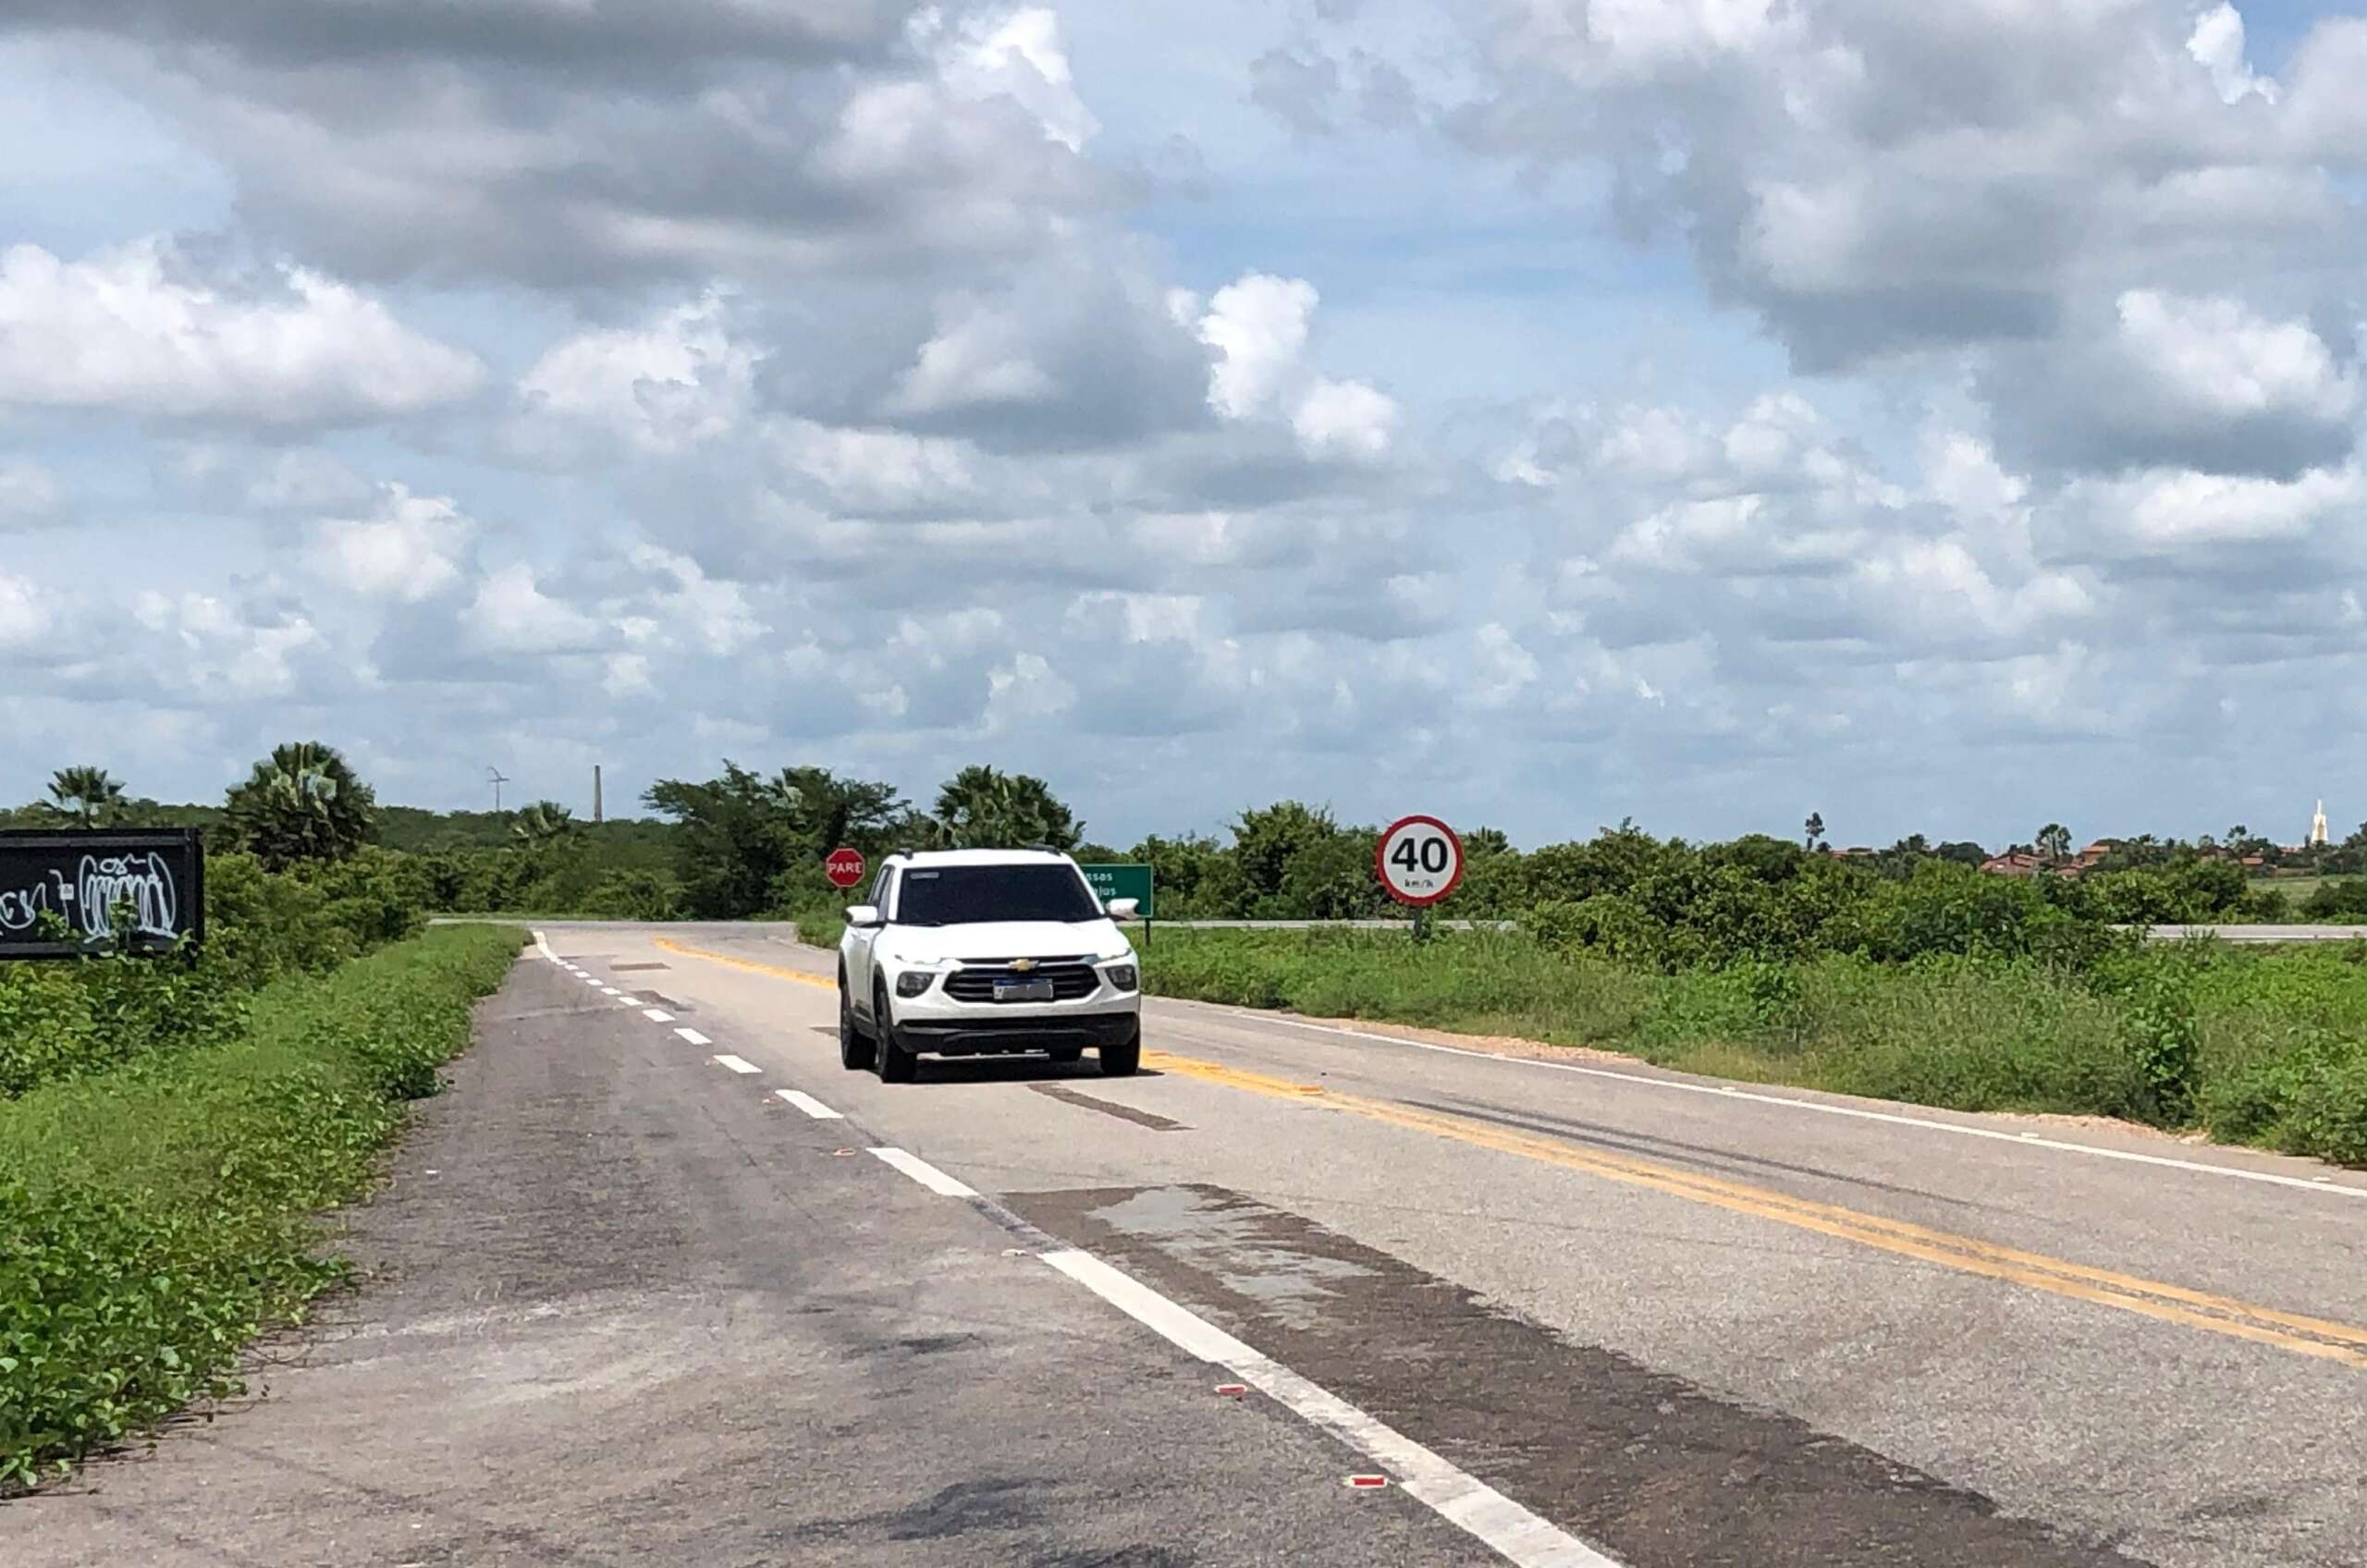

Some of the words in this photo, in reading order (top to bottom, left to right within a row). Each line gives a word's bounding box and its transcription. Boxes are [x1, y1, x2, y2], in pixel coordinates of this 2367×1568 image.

[1391, 837, 1448, 874] 40
[828, 862, 863, 874] PARE
[1404, 879, 1434, 888] km/h
